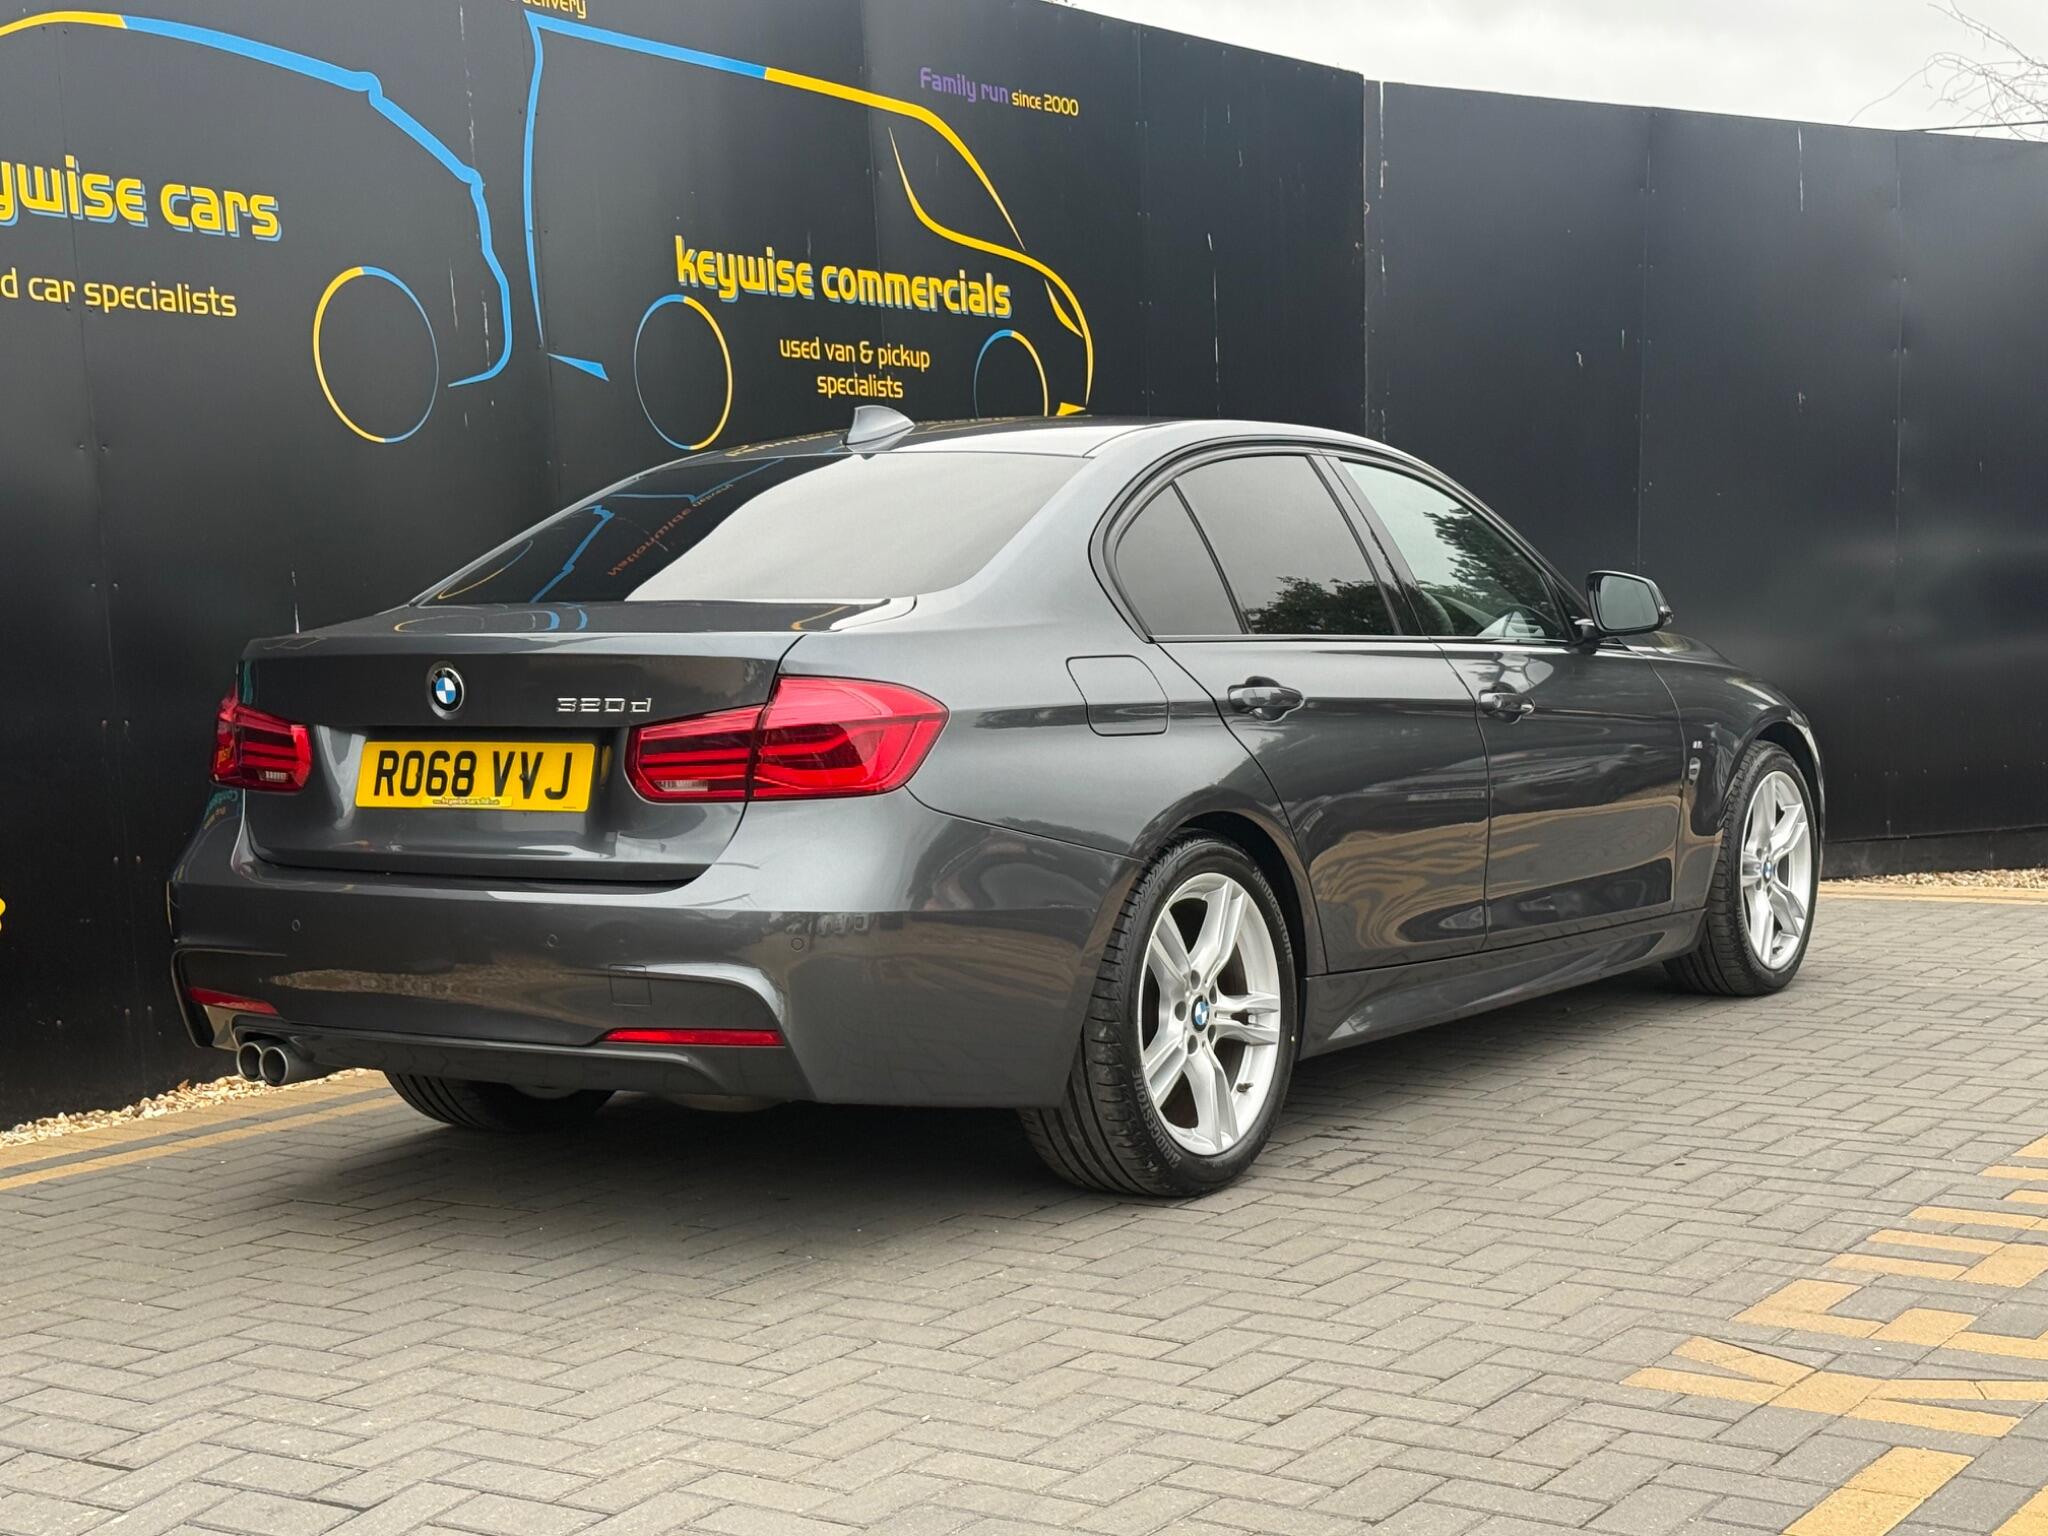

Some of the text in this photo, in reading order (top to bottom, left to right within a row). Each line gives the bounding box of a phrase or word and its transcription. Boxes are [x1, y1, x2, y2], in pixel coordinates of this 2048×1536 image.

[522, 0, 587, 19] ivery
[920, 67, 1079, 116] Family run since 2000
[160, 183, 282, 242] cars
[28, 277, 76, 304] car
[83, 281, 238, 317] specialists
[674, 234, 1013, 319] keywise commercials
[780, 337, 931, 372] used van & pickup
[816, 373, 903, 398] specialists
[373, 750, 573, 800] RO68 VVJ
